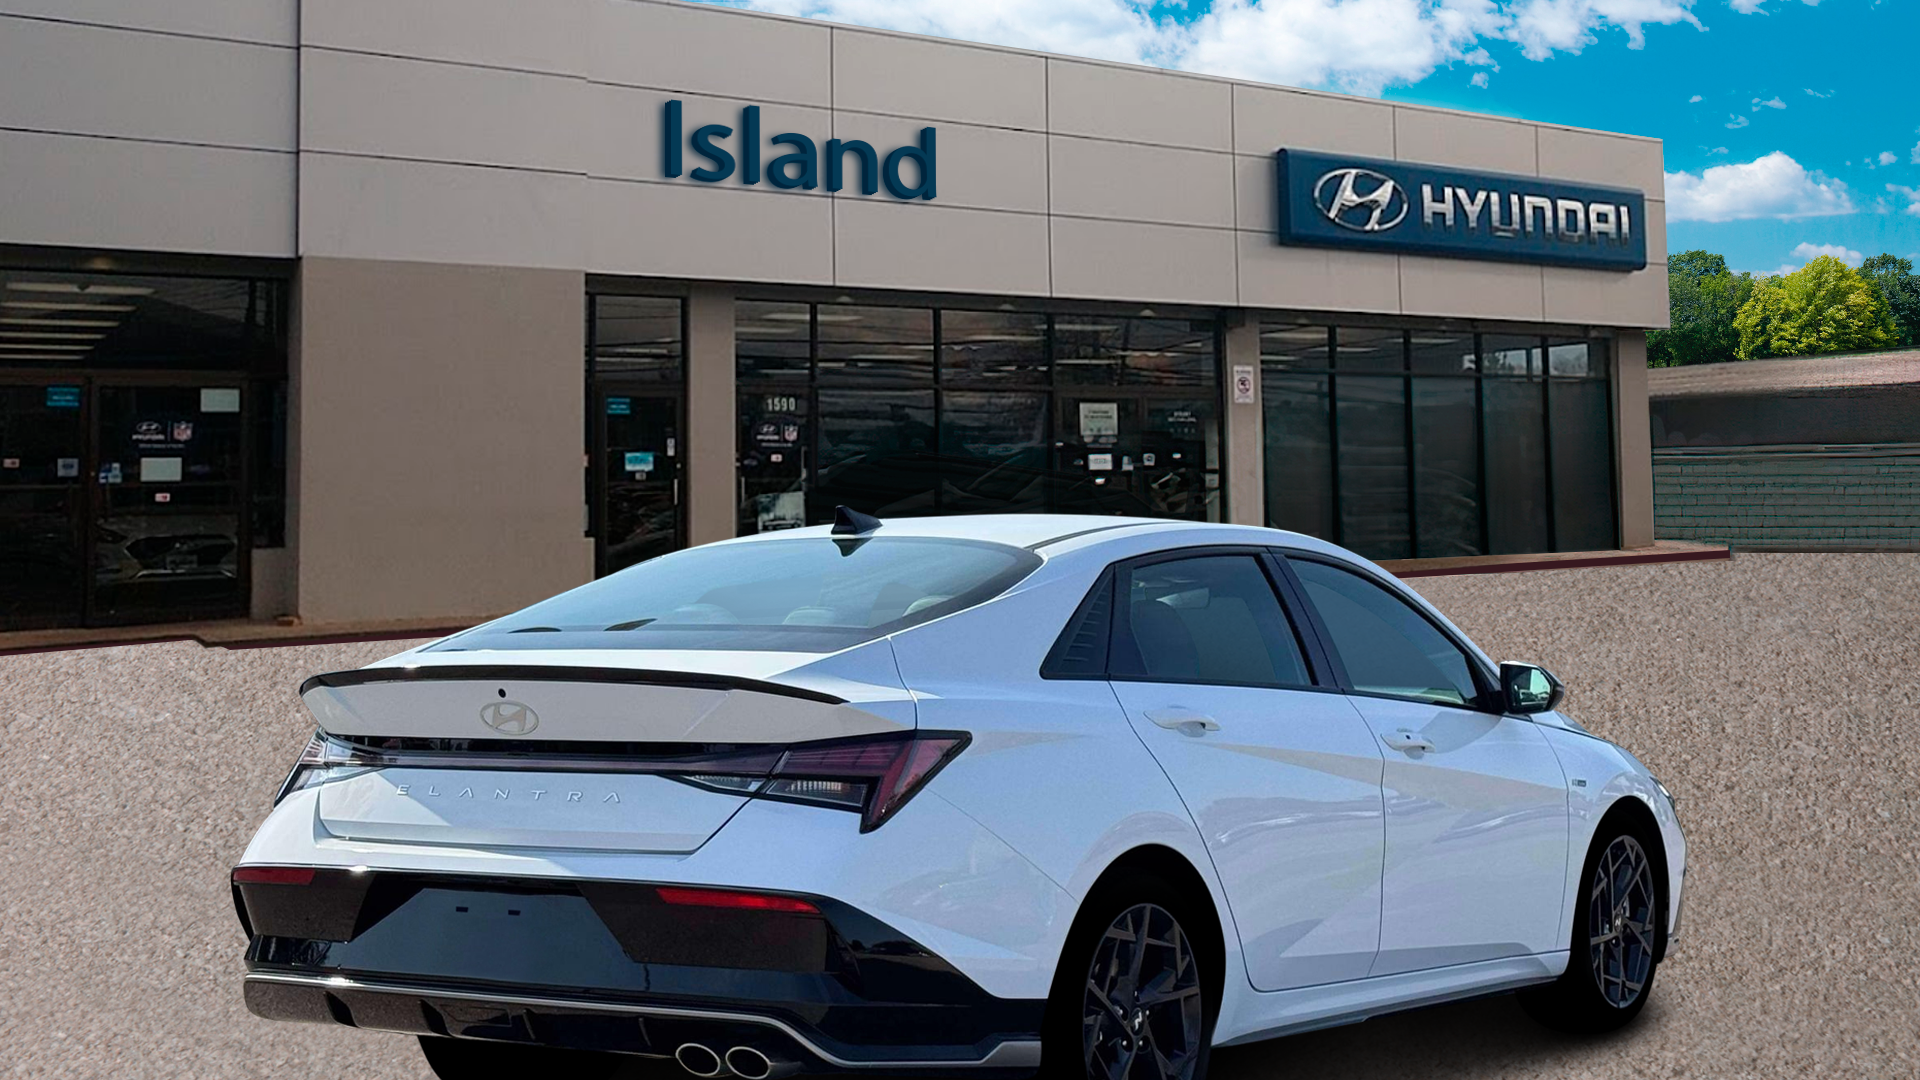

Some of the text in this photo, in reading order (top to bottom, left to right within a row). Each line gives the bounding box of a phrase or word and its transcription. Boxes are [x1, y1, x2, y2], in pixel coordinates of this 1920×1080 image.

[663, 99, 937, 201] Island
[1421, 184, 1631, 247] HYUNDAI
[767, 397, 796, 411] 1590
[396, 784, 621, 804] ELANTRA
